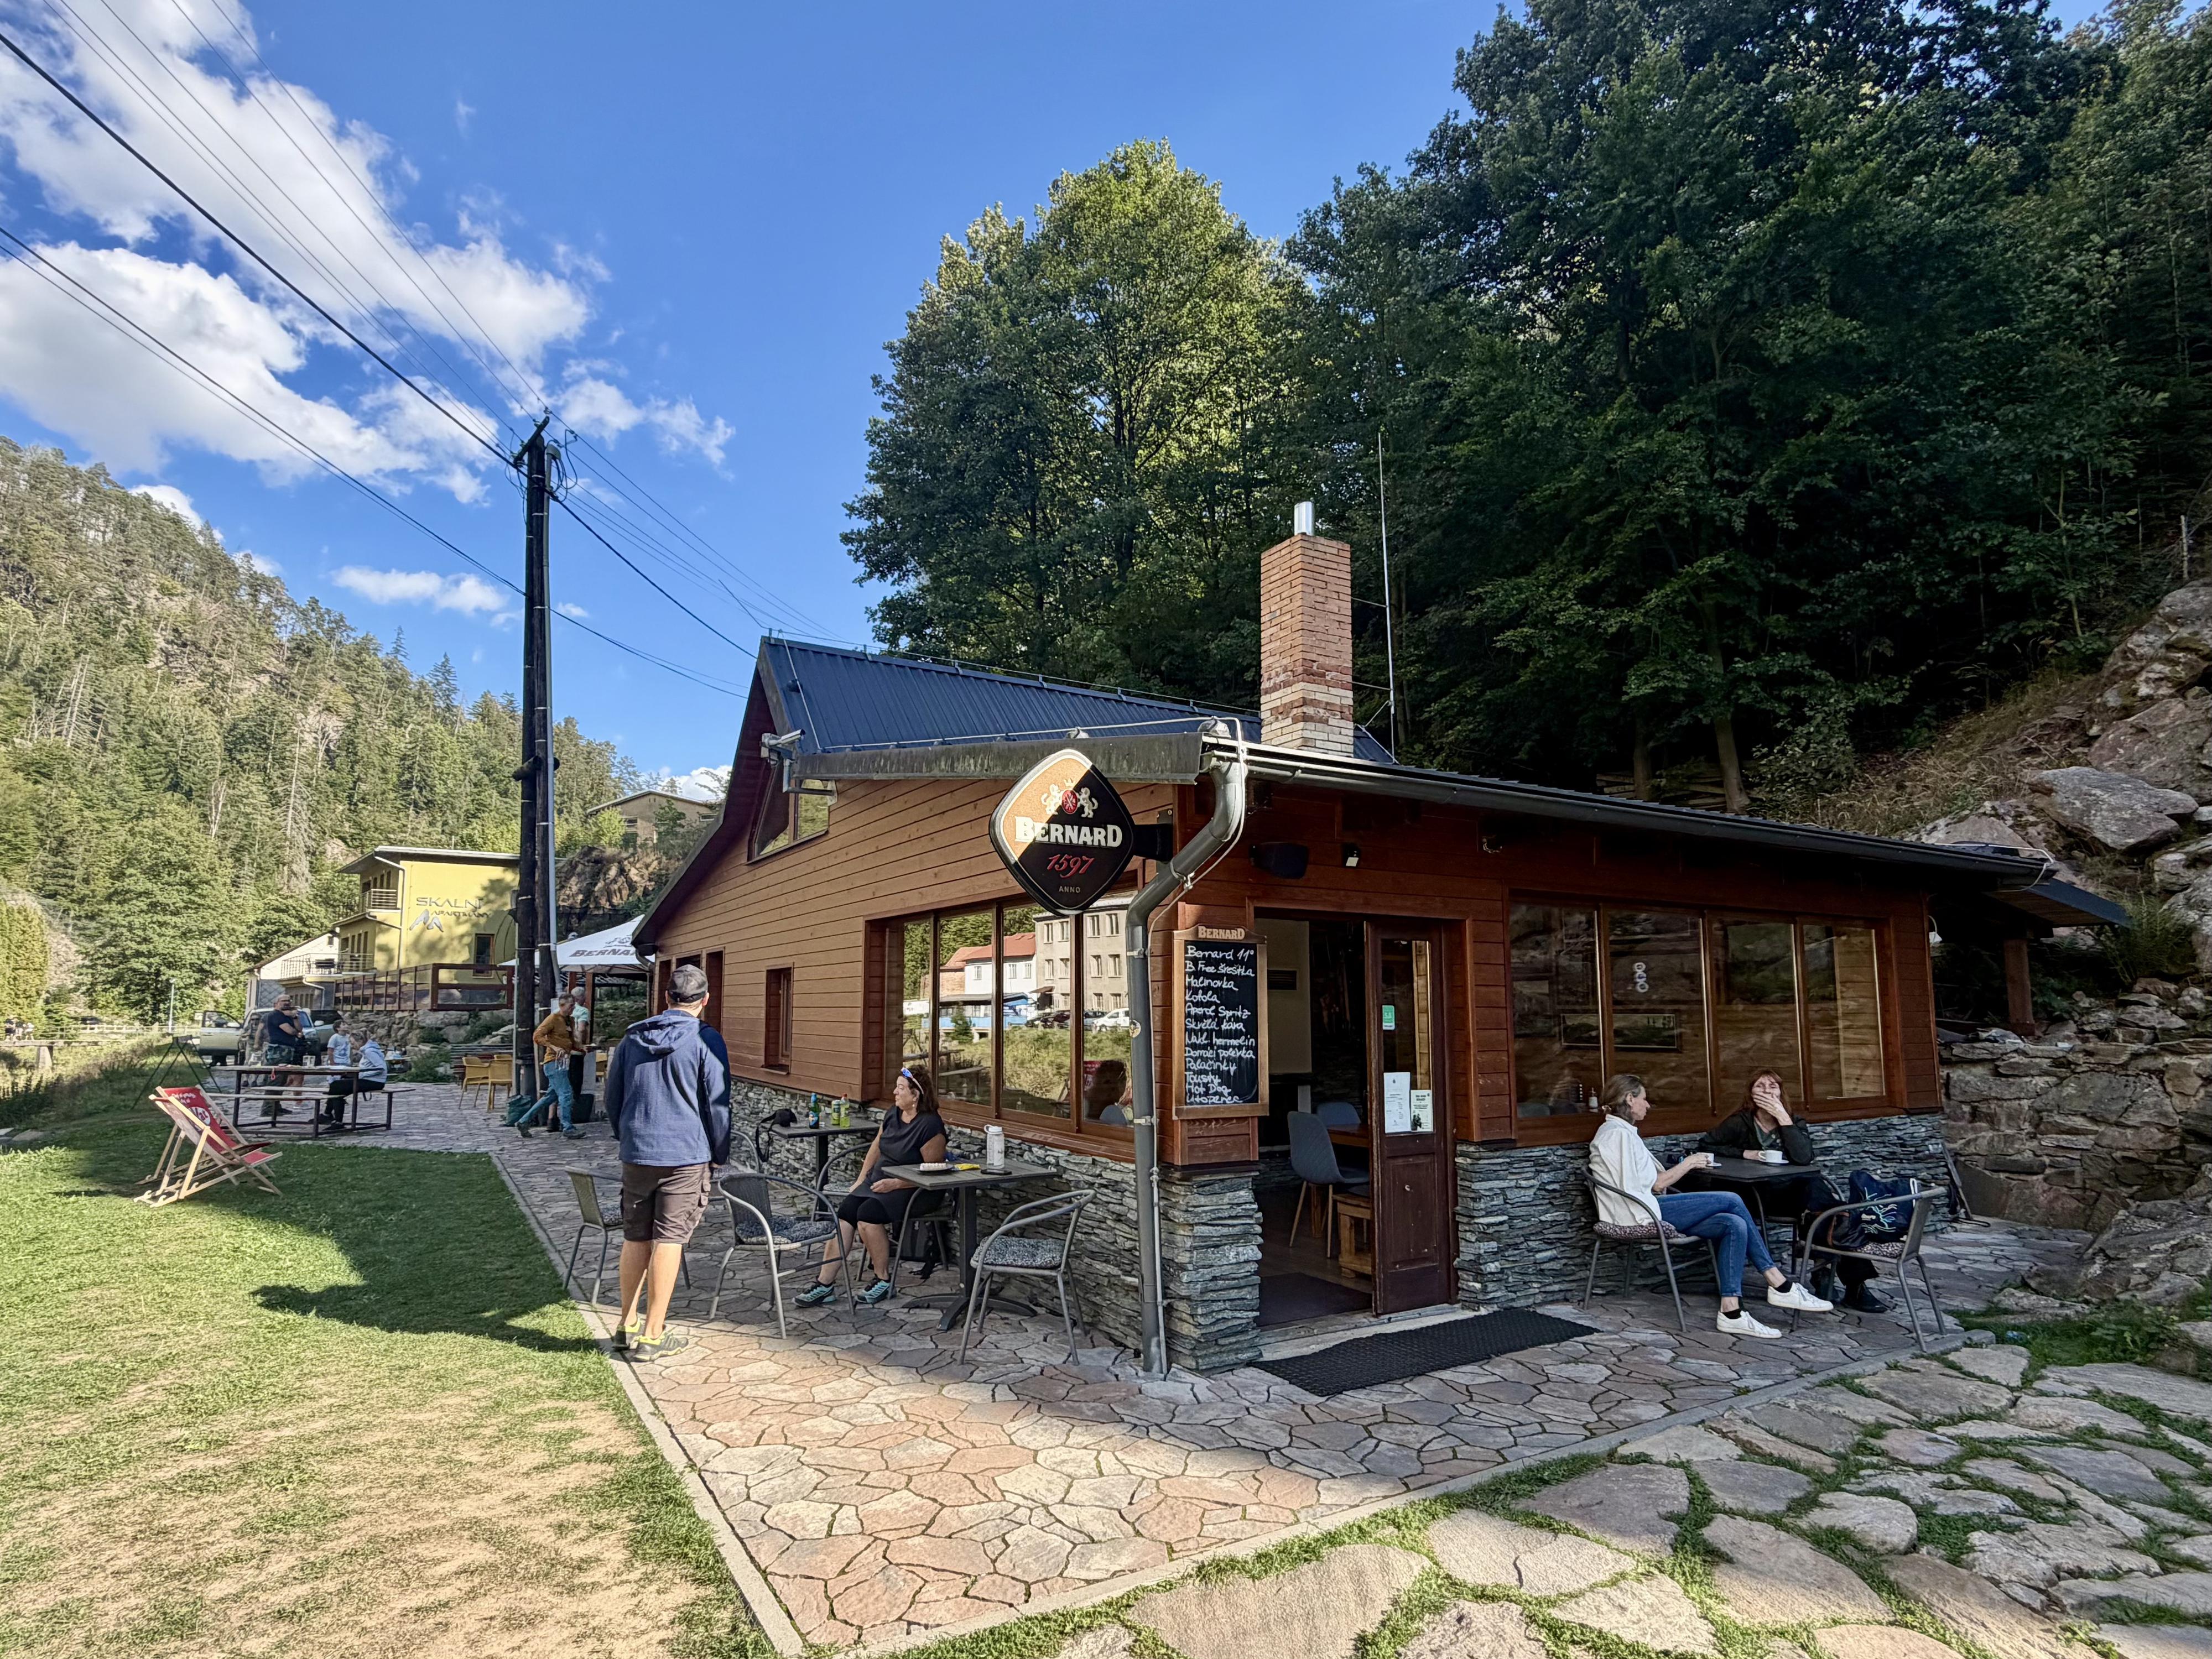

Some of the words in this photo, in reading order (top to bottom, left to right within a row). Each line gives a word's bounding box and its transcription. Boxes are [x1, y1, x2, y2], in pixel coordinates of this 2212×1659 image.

[1014, 816, 1122, 848] BERNARD
[1047, 854, 1095, 878] 1597
[1198, 925, 1245, 940] BERNARD
[1185, 945, 1233, 960] Bernard
[1185, 974, 1239, 990] Malinovka
[1185, 1002, 1216, 1015] Aperol
[1218, 1005, 1251, 1021] Spritz
[1184, 1071, 1221, 1086] Tousty
[1185, 1082, 1206, 1094] Hot
[1208, 1083, 1231, 1097] Dog
